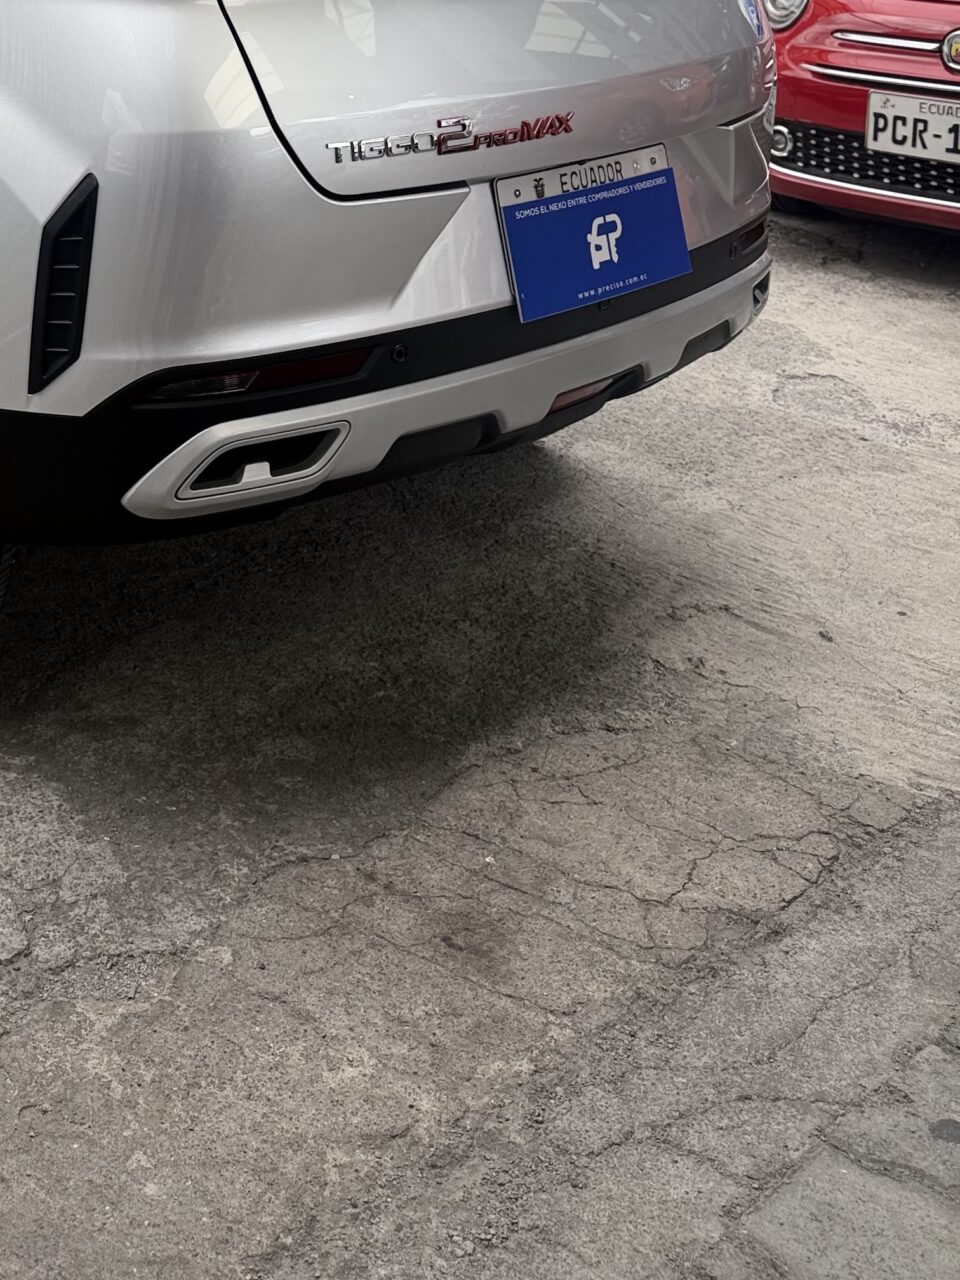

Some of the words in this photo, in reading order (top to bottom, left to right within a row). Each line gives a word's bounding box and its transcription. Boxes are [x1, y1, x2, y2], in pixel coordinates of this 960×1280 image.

[560, 160, 624, 193] ECUADOR
[515, 206, 540, 220] SOMOS
[540, 204, 549, 213] EL
[549, 200, 567, 212] NEXO
[568, 196, 588, 208] ENTRE
[588, 186, 631, 203] COMPRADORES
[633, 175, 667, 192] VENDEDORES
[577, 273, 648, 300] www.preciso.com.ec
